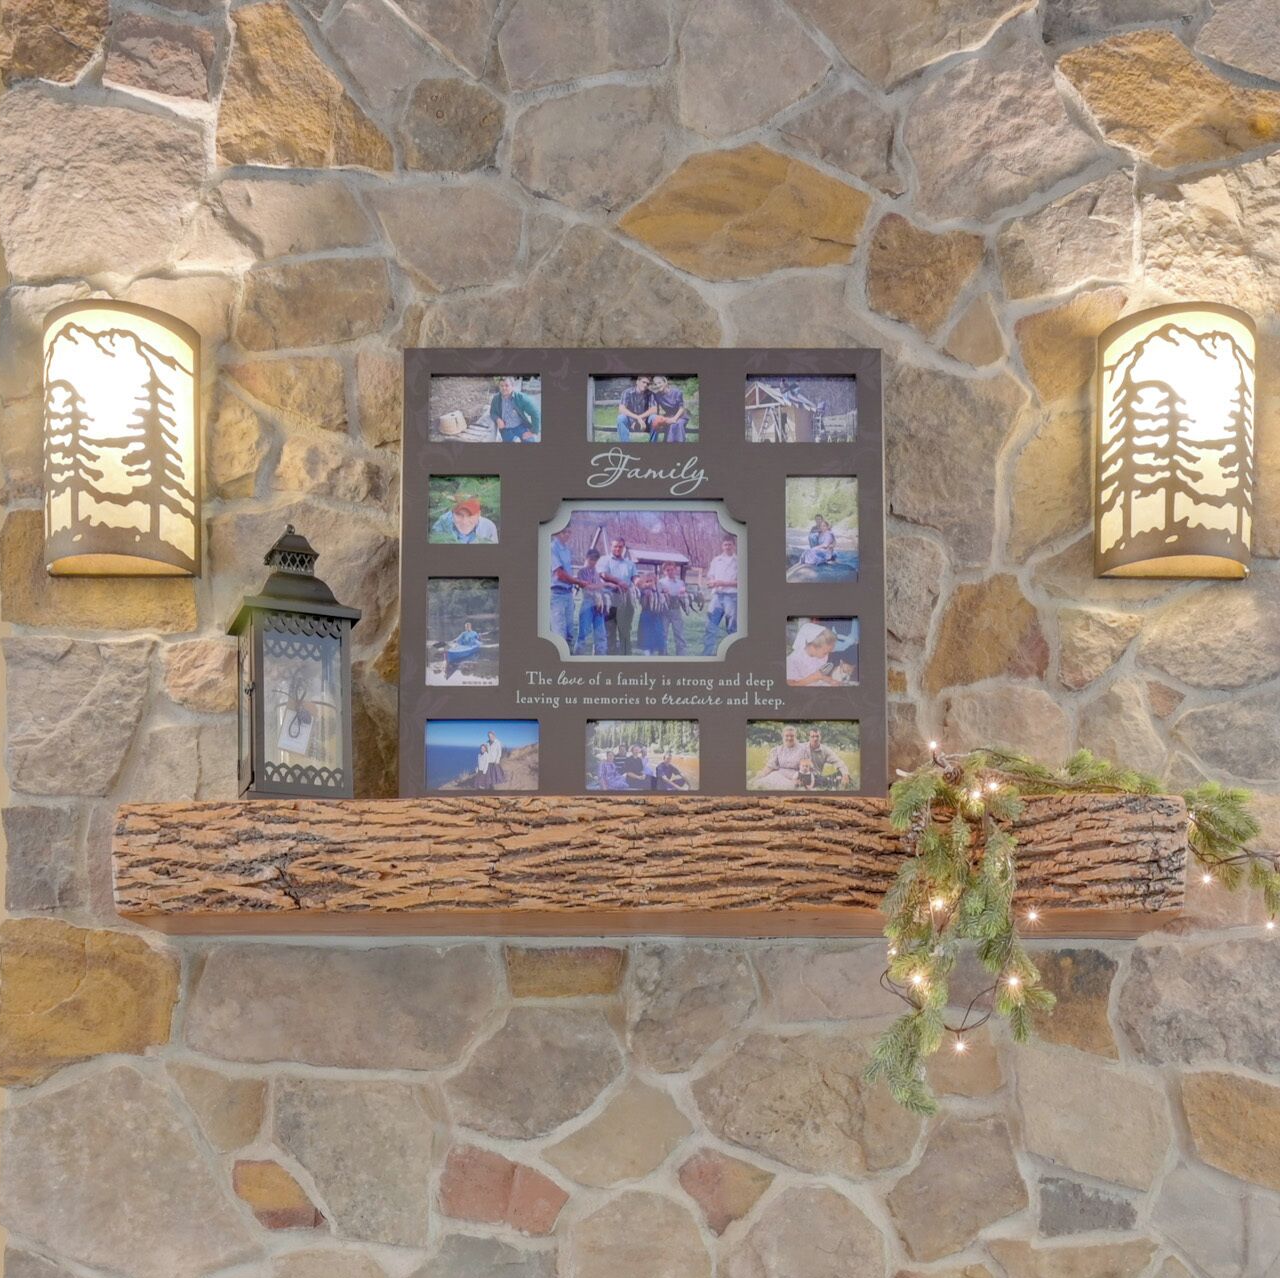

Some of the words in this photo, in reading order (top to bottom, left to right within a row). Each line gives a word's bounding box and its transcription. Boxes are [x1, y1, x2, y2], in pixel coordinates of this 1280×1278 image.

[586, 447, 709, 496] Family
[526, 671, 553, 686] The
[557, 670, 585, 686] love
[588, 671, 602, 686] of
[606, 678, 612, 686] a
[617, 671, 656, 690] family
[662, 674, 672, 686] is
[676, 676, 714, 690] strong
[718, 672, 741, 686] and
[745, 671, 775, 691] deep
[516, 691, 560, 708] leaving
[565, 696, 578, 705] us
[583, 694, 640, 705] memories
[646, 695, 657, 705] to
[727, 691, 750, 705] and
[754, 691, 785, 710] keep.
